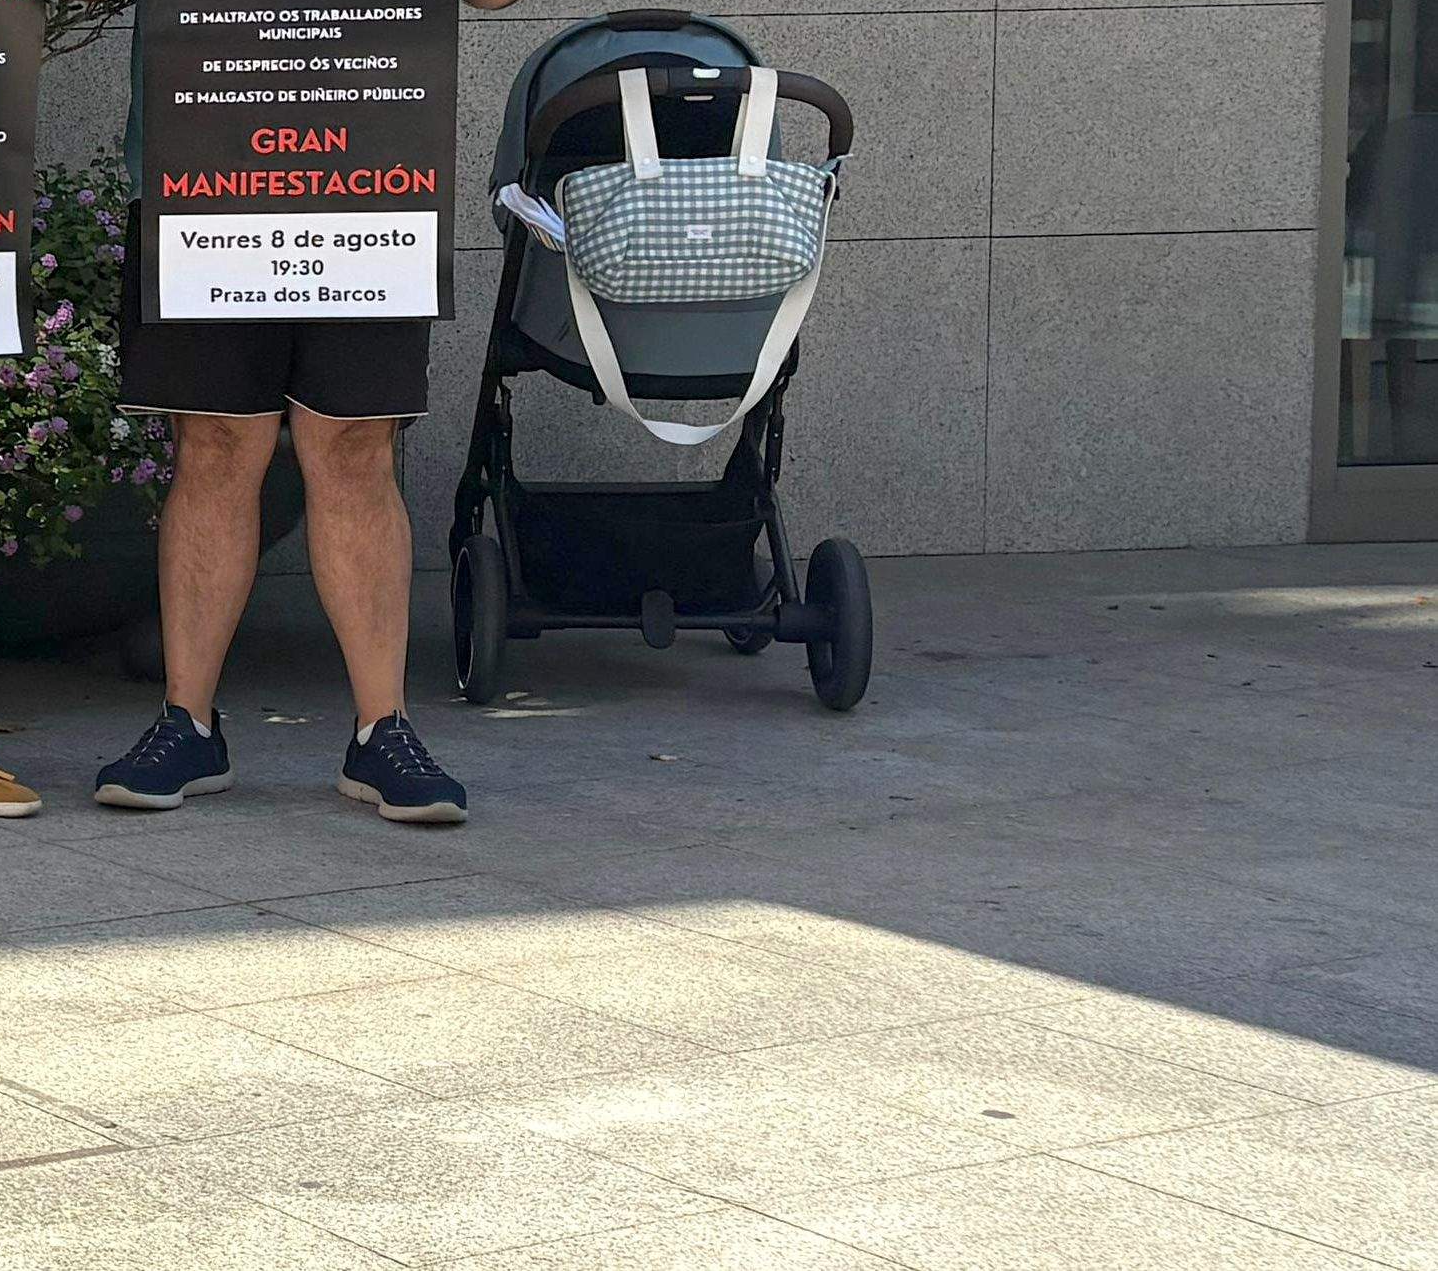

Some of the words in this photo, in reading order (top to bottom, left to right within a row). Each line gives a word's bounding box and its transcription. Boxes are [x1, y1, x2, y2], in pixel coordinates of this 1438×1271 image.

[179, 12, 199, 24] DE
[201, 10, 276, 24] MALTRATO
[278, 9, 300, 22] OS
[302, 7, 423, 22] TRABALLADORES
[258, 26, 343, 40] MUNICIPAIS
[202, 60, 222, 73] DE
[225, 58, 306, 72] DESPRECIO
[309, 56, 330, 71] ÓS
[333, 55, 398, 70] VECIÑOS
[174, 91, 194, 104] DE
[197, 90, 275, 104] MALGASTO
[277, 90, 298, 102] DE
[300, 87, 360, 102] DIÑEIRO
[362, 86, 426, 101] PÚBLICO
[251, 127, 348, 155] GRAN
[163, 162, 437, 198] MANIFESTACIÓN
[180, 231, 262, 249] Venres
[271, 229, 285, 249] 8
[294, 229, 325, 248] de
[332, 229, 416, 252] agosto
[270, 259, 324, 276] 19:30
[210, 287, 267, 303] Praza
[273, 286, 311, 303] dos
[318, 286, 386, 302] Barcos
